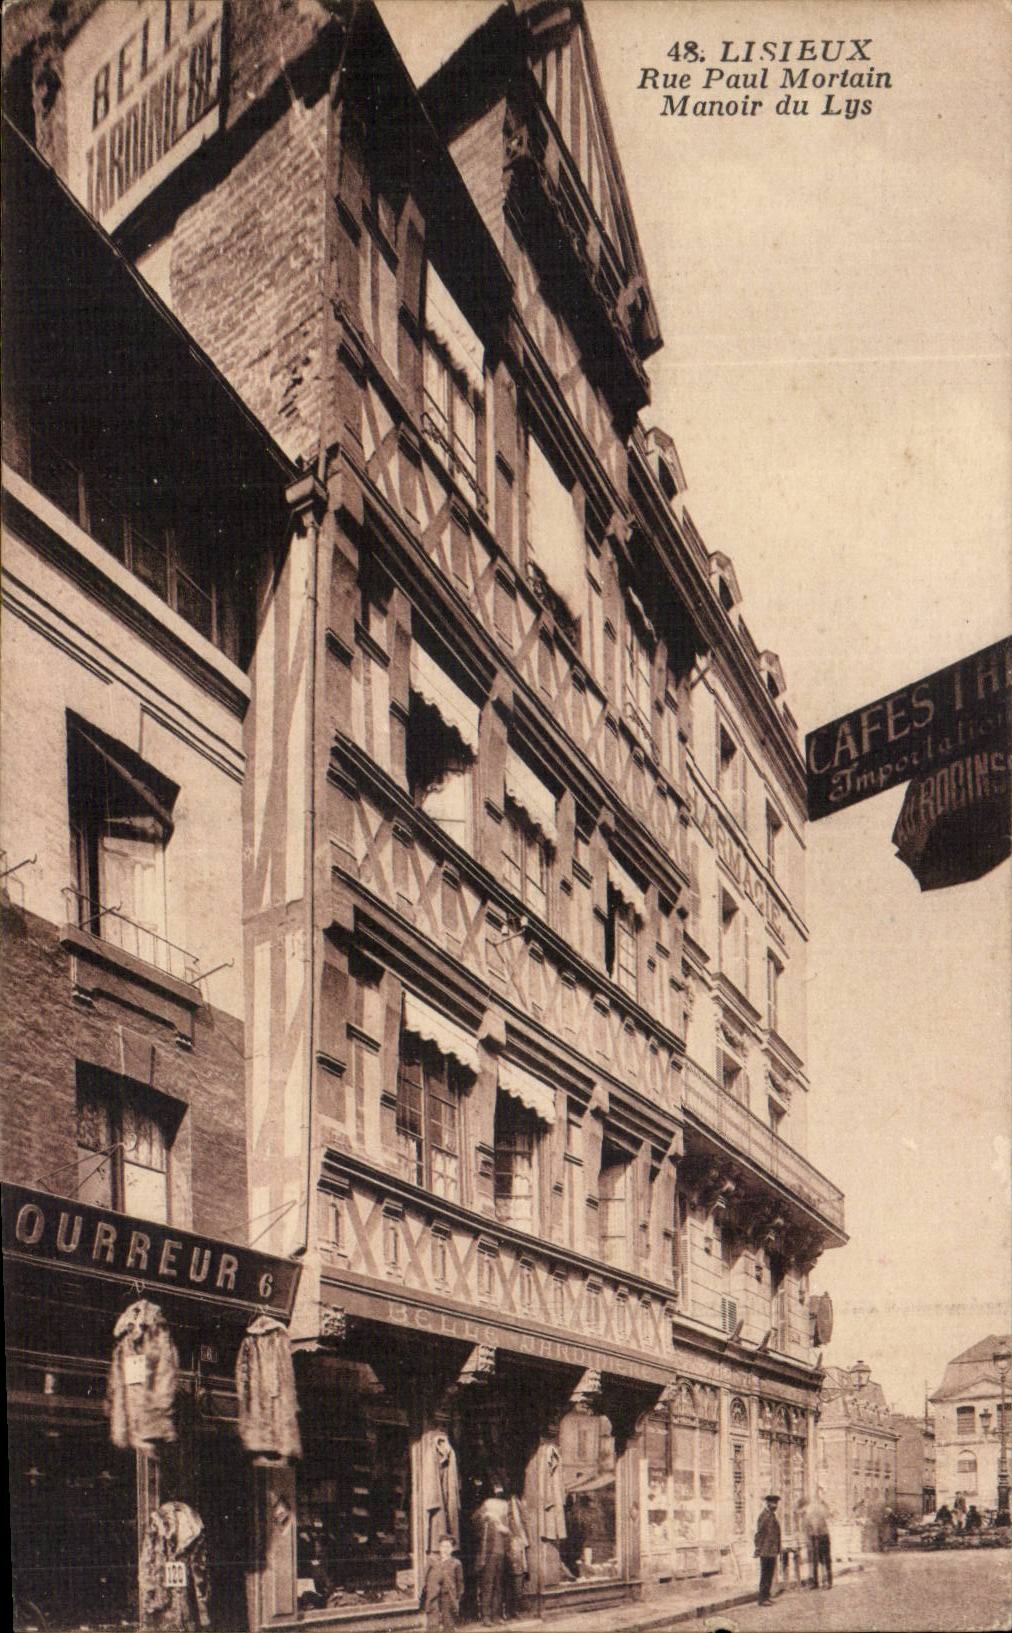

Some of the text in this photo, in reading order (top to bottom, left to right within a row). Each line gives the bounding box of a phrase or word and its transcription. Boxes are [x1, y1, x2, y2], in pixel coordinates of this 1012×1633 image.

[809, 683, 935, 775] CAFES
[258, 1272, 274, 1299] 6
[390, 1302, 498, 1342] BELLE
